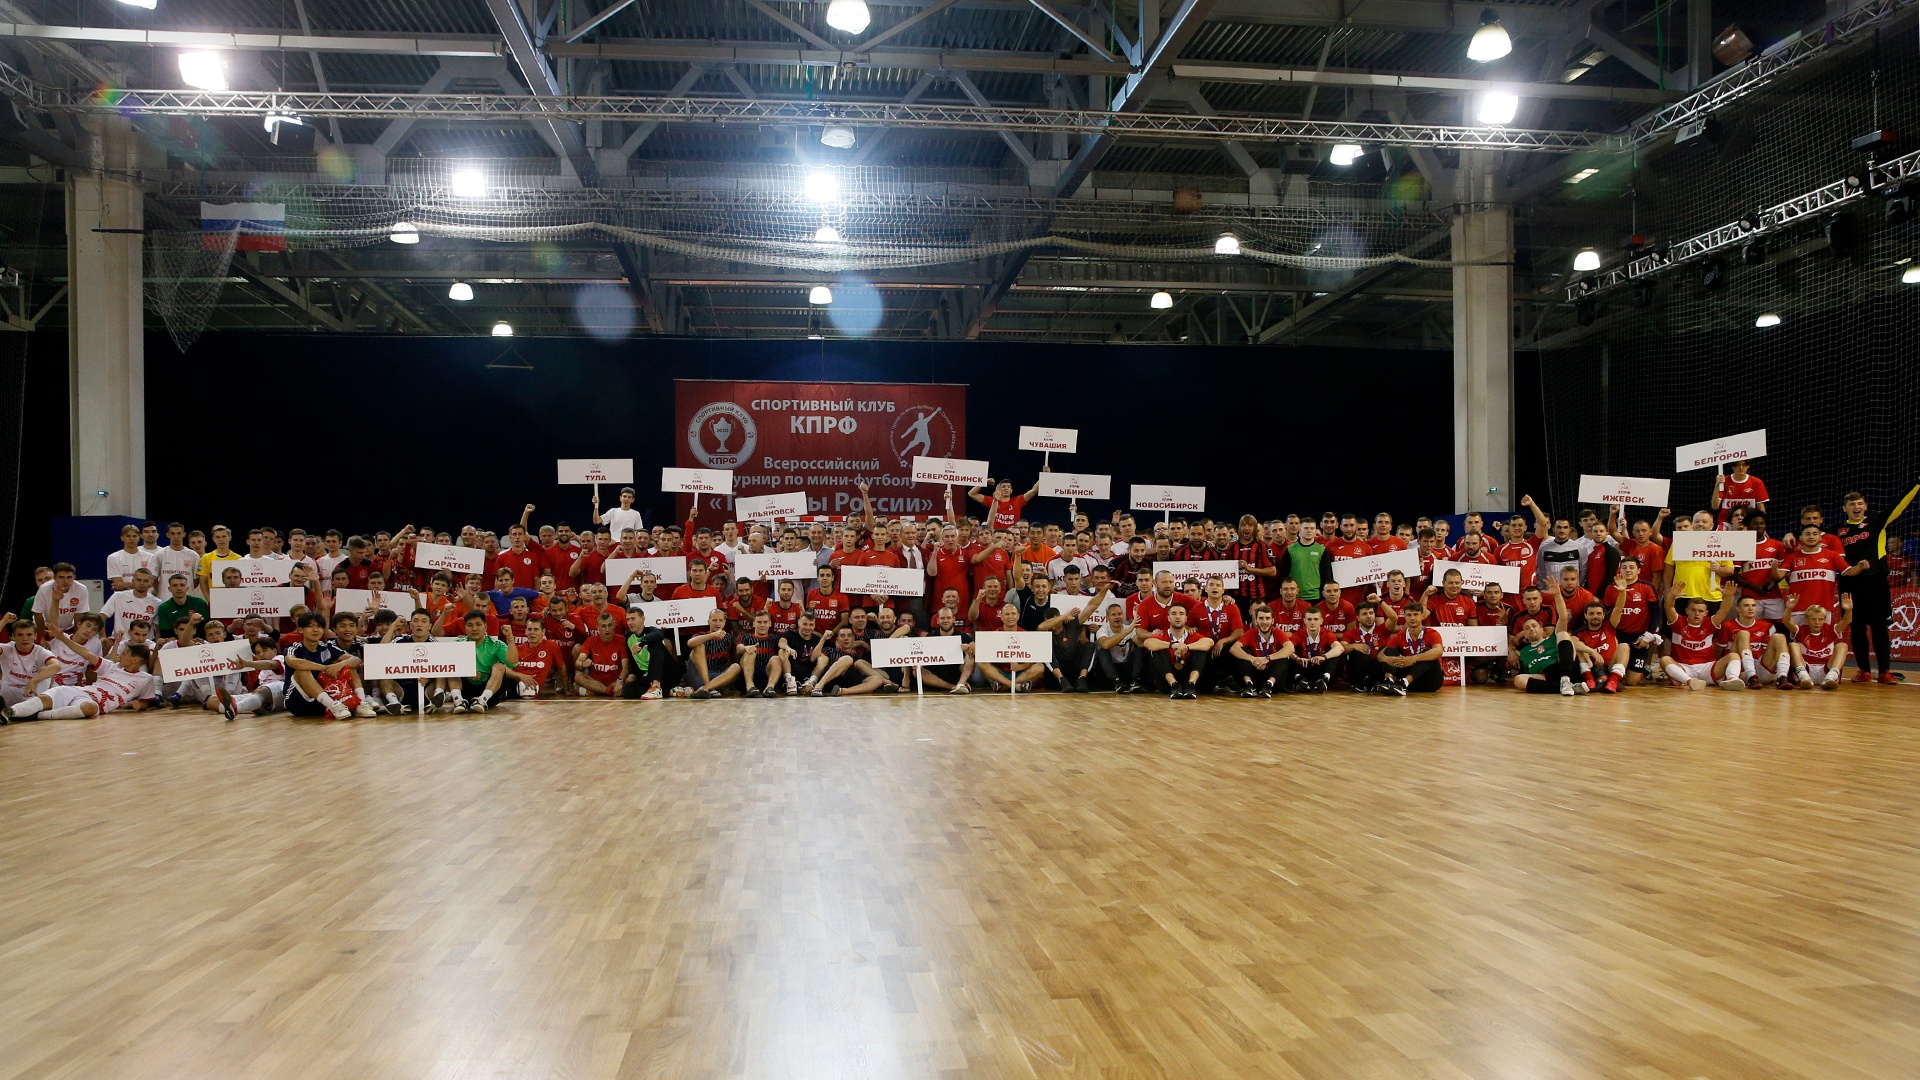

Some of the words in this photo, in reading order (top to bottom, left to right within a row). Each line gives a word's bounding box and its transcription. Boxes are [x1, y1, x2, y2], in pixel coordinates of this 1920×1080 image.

[751, 398, 854, 412] СПОРТИВНЫЙ
[858, 401, 896, 413] КЛУБ
[791, 415, 858, 435] КПРФ
[1029, 441, 1067, 450] ЧУВАШИЯ
[708, 456, 738, 465] КПРФ
[1694, 450, 1748, 467] БЕЛГОРОД
[763, 456, 880, 472] Всероссийский
[733, 474, 783, 489] урнир
[785, 475, 804, 486] по
[807, 473, 917, 491] мини-футболу
[916, 472, 984, 484] СЕВЕРОДВИНСК
[680, 483, 714, 491] ТЮМЕНЬ
[1054, 488, 1094, 497] РЫБИНСК
[835, 492, 933, 513] России»
[1602, 494, 1645, 504] ИЖЕВСК
[1135, 501, 1199, 511] НОВОСИБИРСК
[747, 507, 796, 519] УЛЬЯНОВСК
[1692, 550, 1736, 558] РЯЗАНЬ
[428, 559, 472, 570] САРАТОВ
[758, 569, 794, 577] КАЗАНЬ
[1355, 572, 1391, 584] АНГАР
[1797, 570, 1827, 580] КПРФ
[879, 589, 919, 597] РЕСПУБЛИКА
[122, 611, 151, 621] КПРФ
[237, 607, 279, 615] ЛИПЕЦК
[815, 608, 837, 616] КПРФ
[656, 616, 696, 626] САМАРА
[1275, 622, 1301, 632] КПРФ
[996, 650, 1032, 659] ПЕРМЬ
[889, 655, 946, 665] КОСТРОМА
[1634, 658, 1645, 669] 23
[385, 664, 457, 675] КАЛМЫКИЯ
